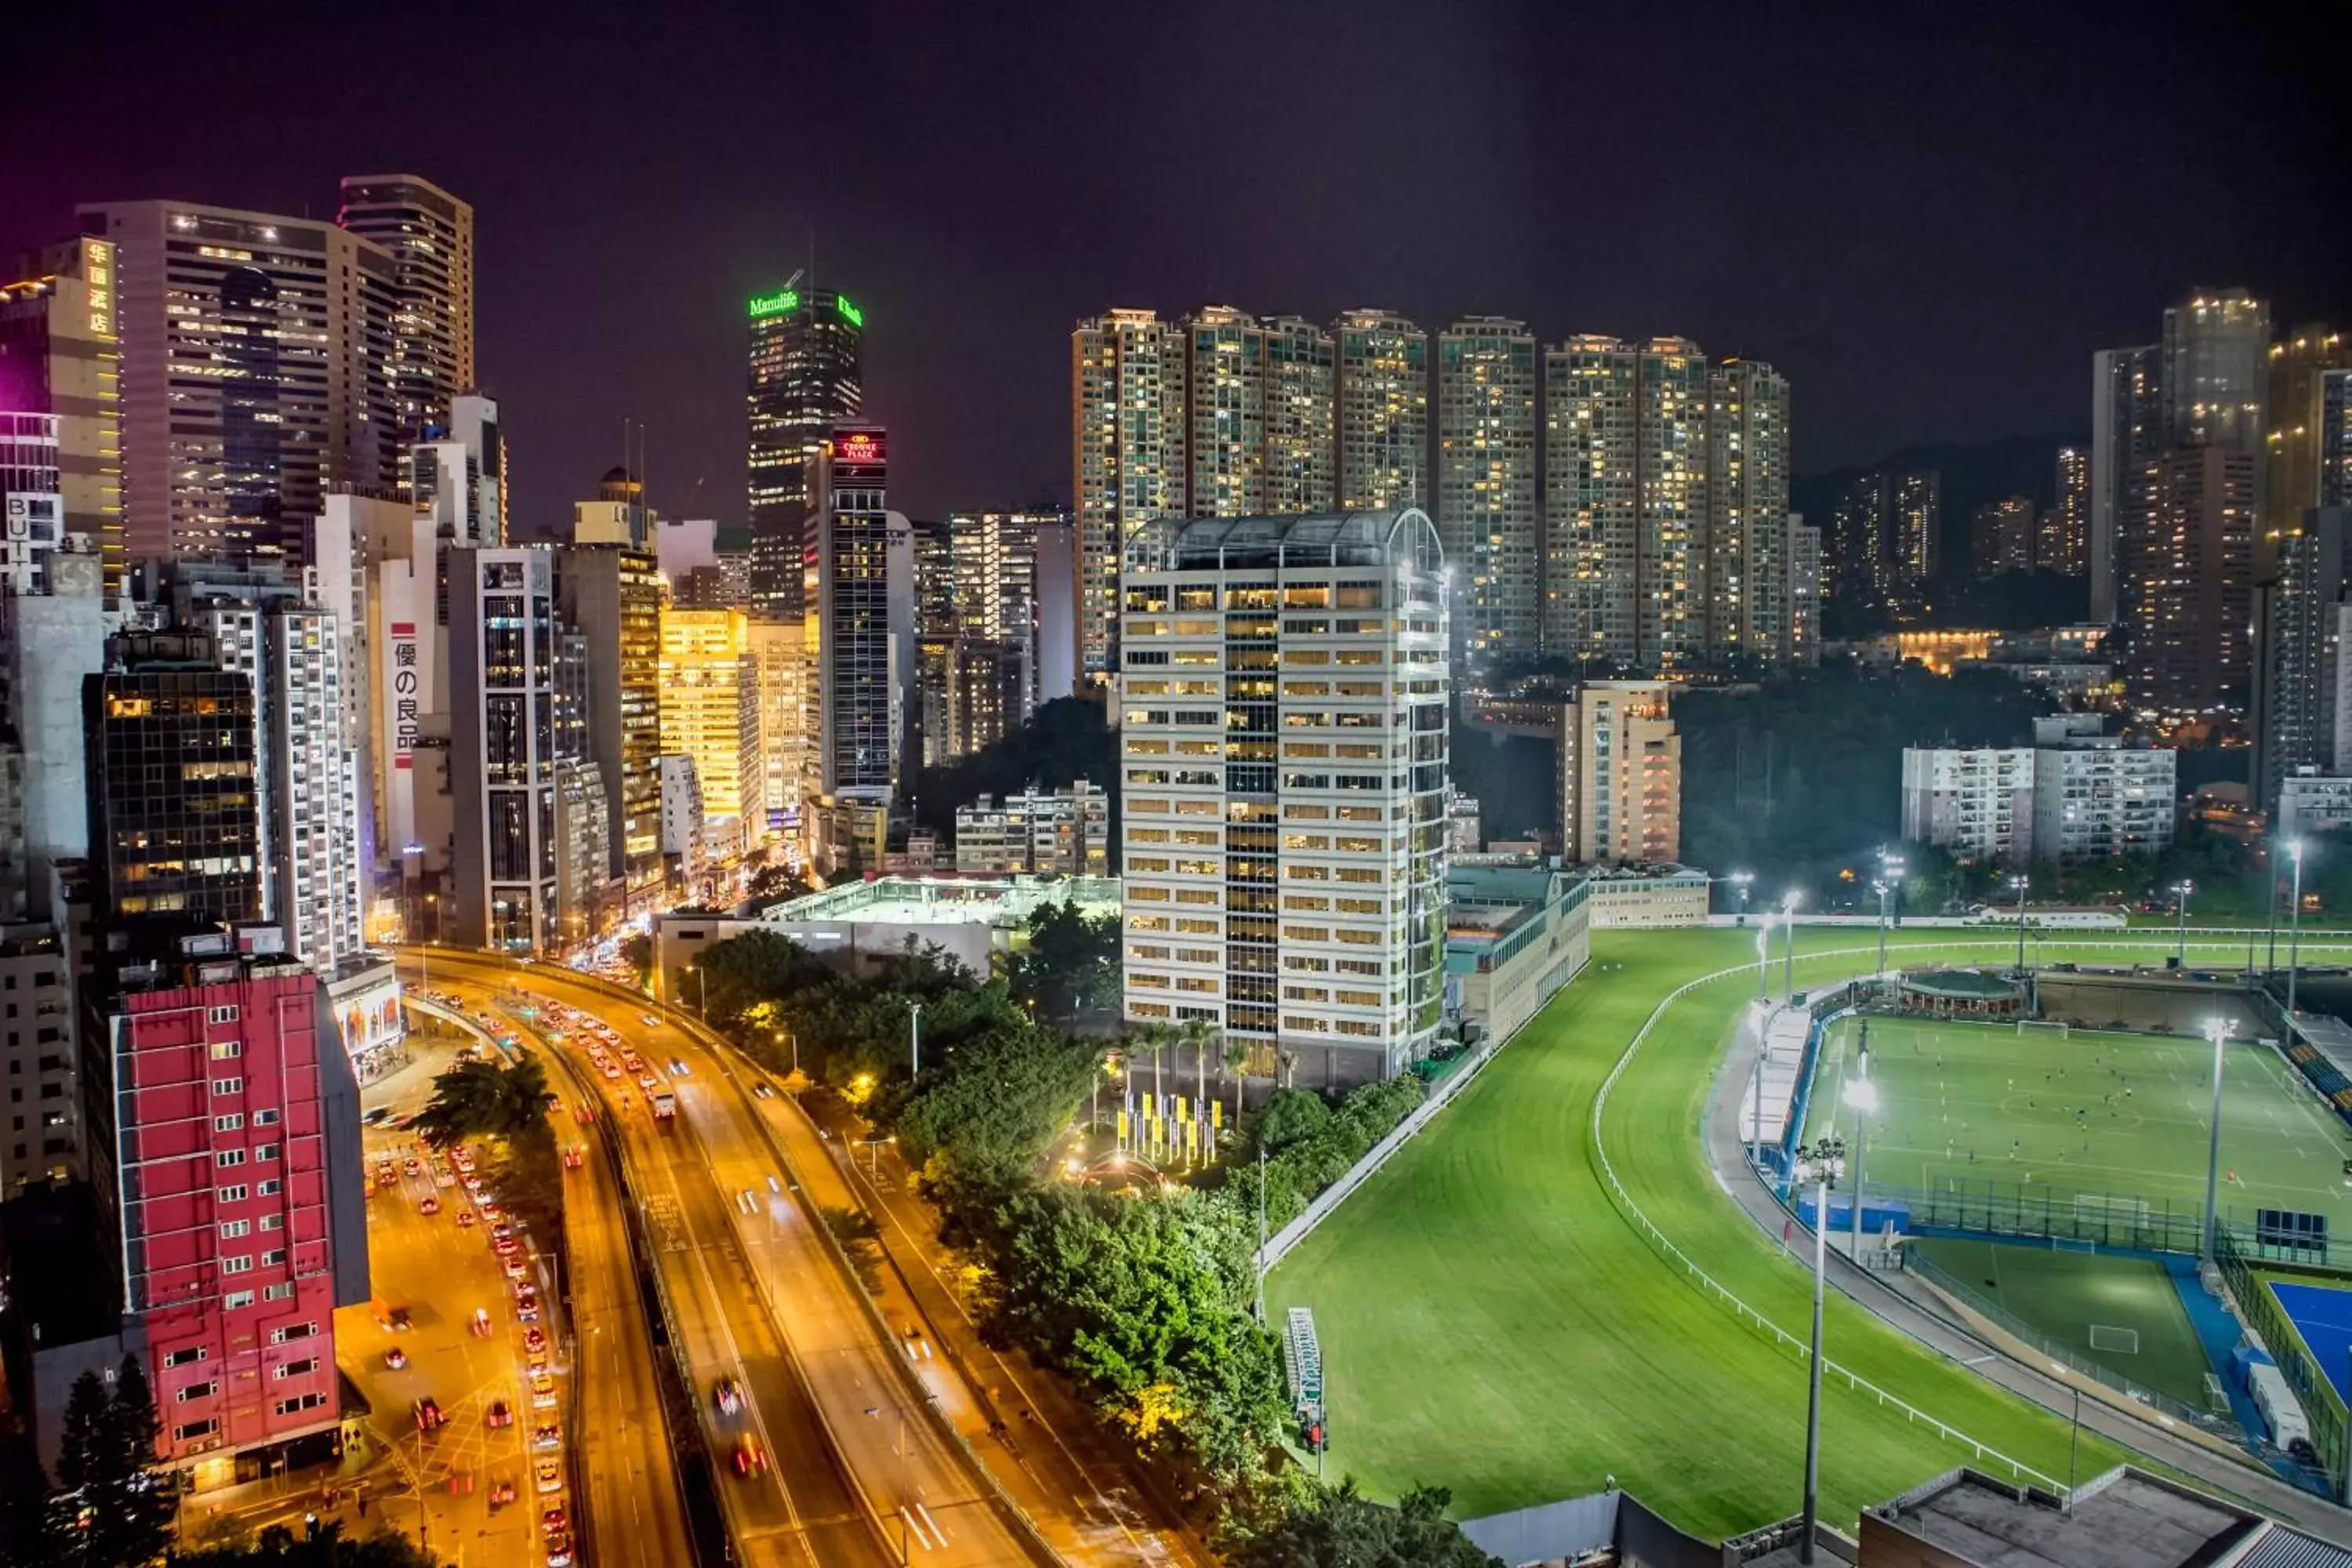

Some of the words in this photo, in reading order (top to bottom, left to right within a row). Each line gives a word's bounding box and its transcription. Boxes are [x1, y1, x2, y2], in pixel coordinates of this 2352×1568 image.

[750, 291, 797, 316] Manulife
[395, 643, 418, 749] 優の良品
